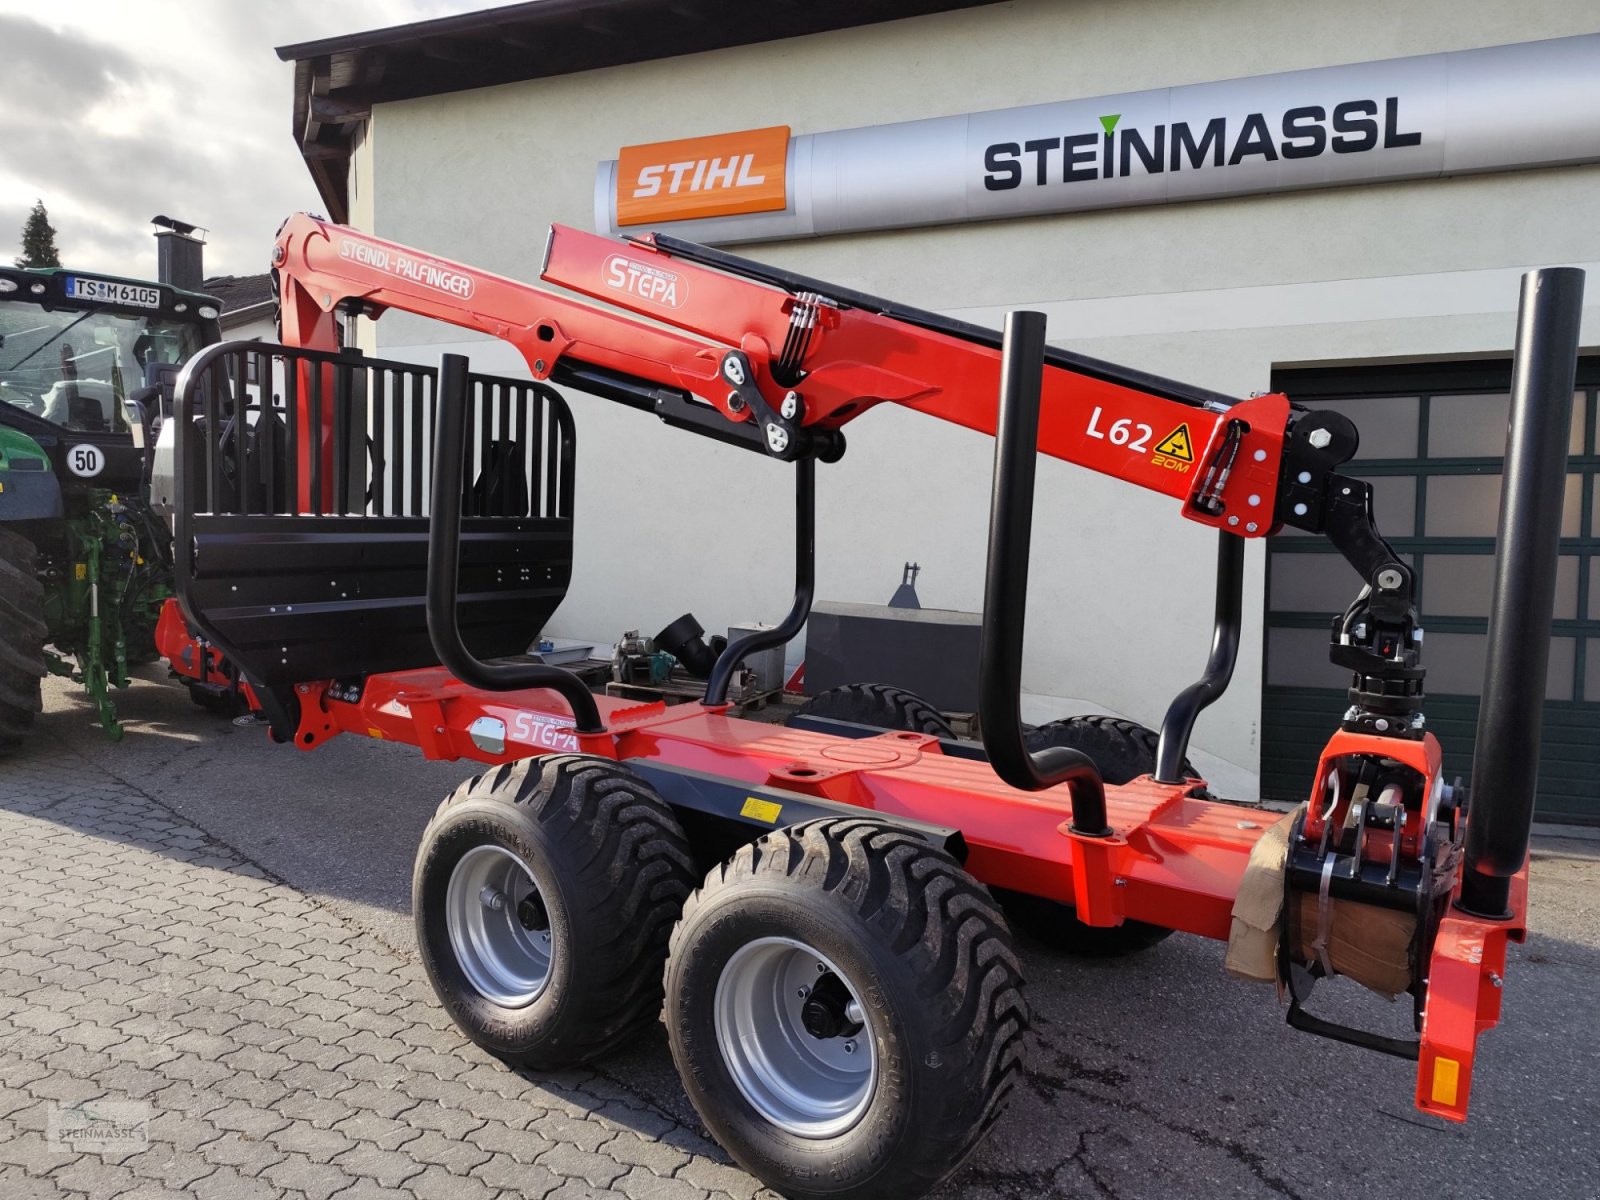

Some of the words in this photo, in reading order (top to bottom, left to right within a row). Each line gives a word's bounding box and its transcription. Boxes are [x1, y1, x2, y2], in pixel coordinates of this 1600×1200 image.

[984, 97, 1421, 191] STEINMASSL
[633, 153, 765, 198] STIHL
[341, 240, 470, 296] STEINDL-PALFINGER
[607, 257, 676, 307] STEPA
[76, 280, 97, 296] TS
[107, 284, 117, 299] M
[120, 287, 157, 304] 6105
[1086, 406, 1152, 453] L62
[75, 450, 97, 471] 50
[1151, 455, 1190, 473] 20M
